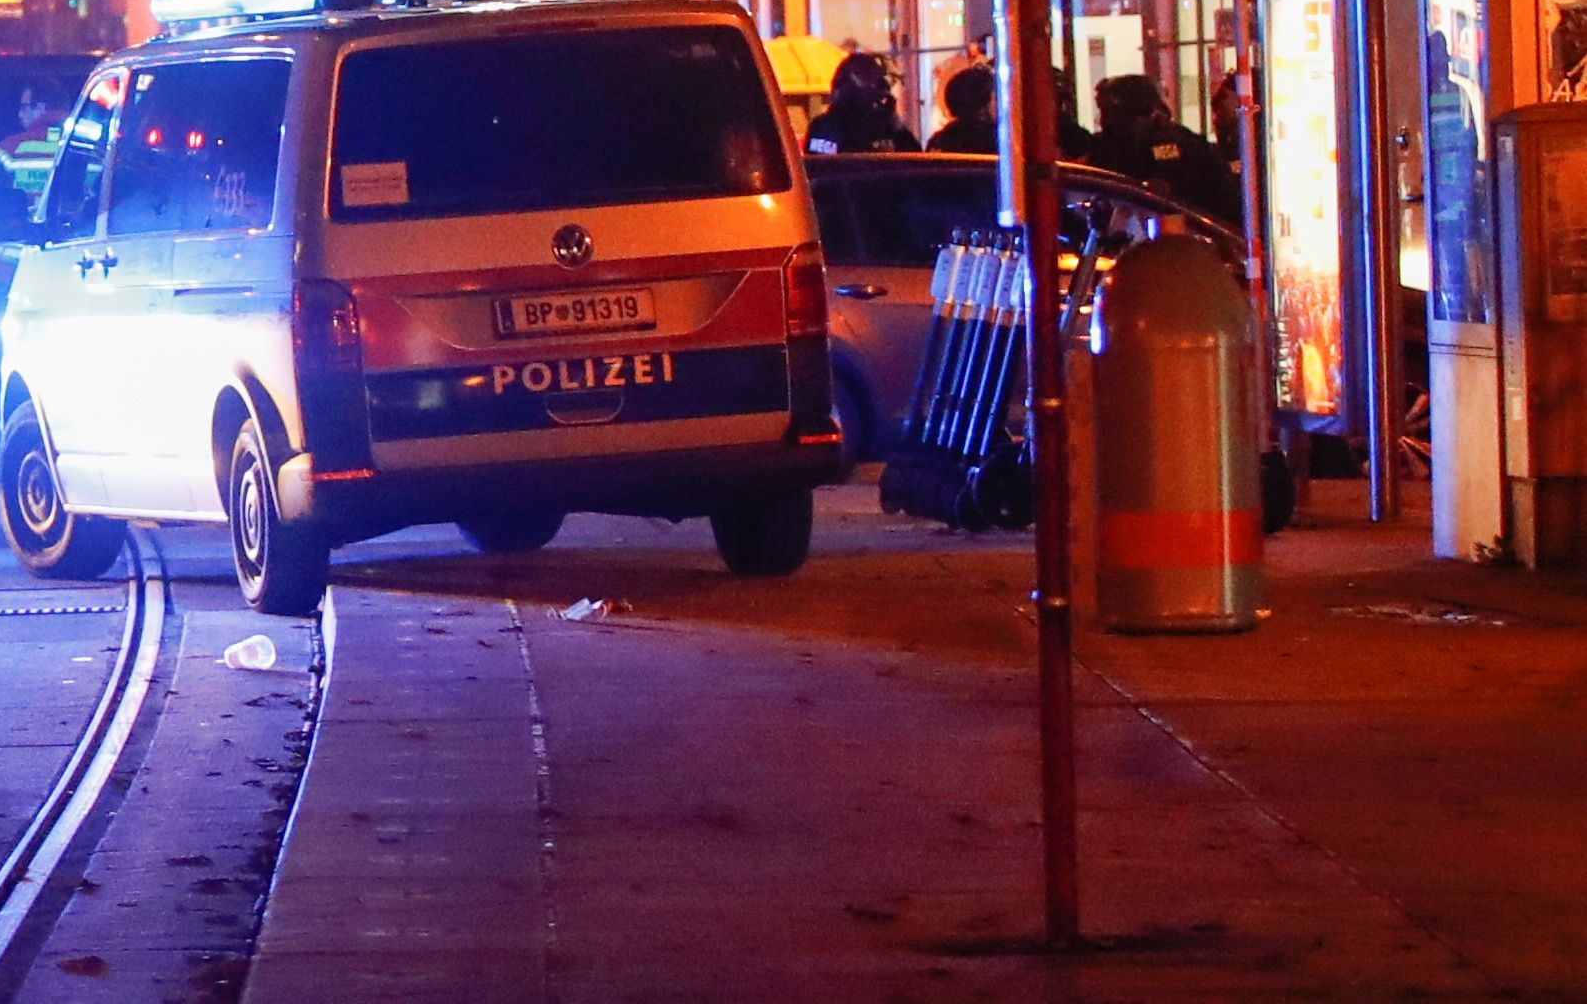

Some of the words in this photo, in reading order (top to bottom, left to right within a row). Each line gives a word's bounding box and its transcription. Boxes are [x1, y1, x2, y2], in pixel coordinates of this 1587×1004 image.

[525, 303, 553, 325] BP
[571, 296, 639, 322] 91319
[492, 353, 675, 394] POLIZEI
